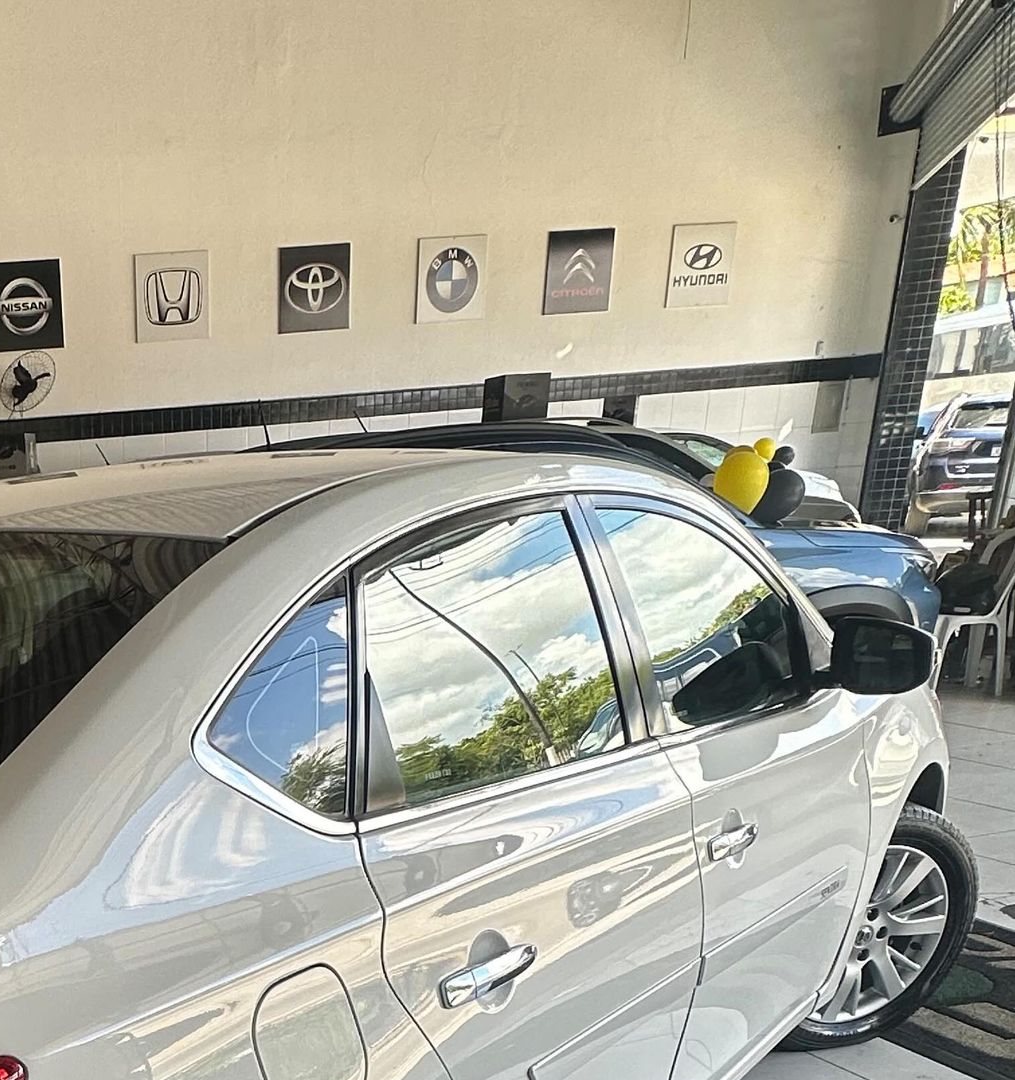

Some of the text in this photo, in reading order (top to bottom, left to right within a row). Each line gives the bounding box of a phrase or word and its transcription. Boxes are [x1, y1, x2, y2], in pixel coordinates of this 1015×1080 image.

[432, 248, 474, 270] BMW
[673, 273, 728, 289] HYUNDAI
[551, 284, 605, 299] CITROËN
[0, 300, 48, 314] NISSAN
